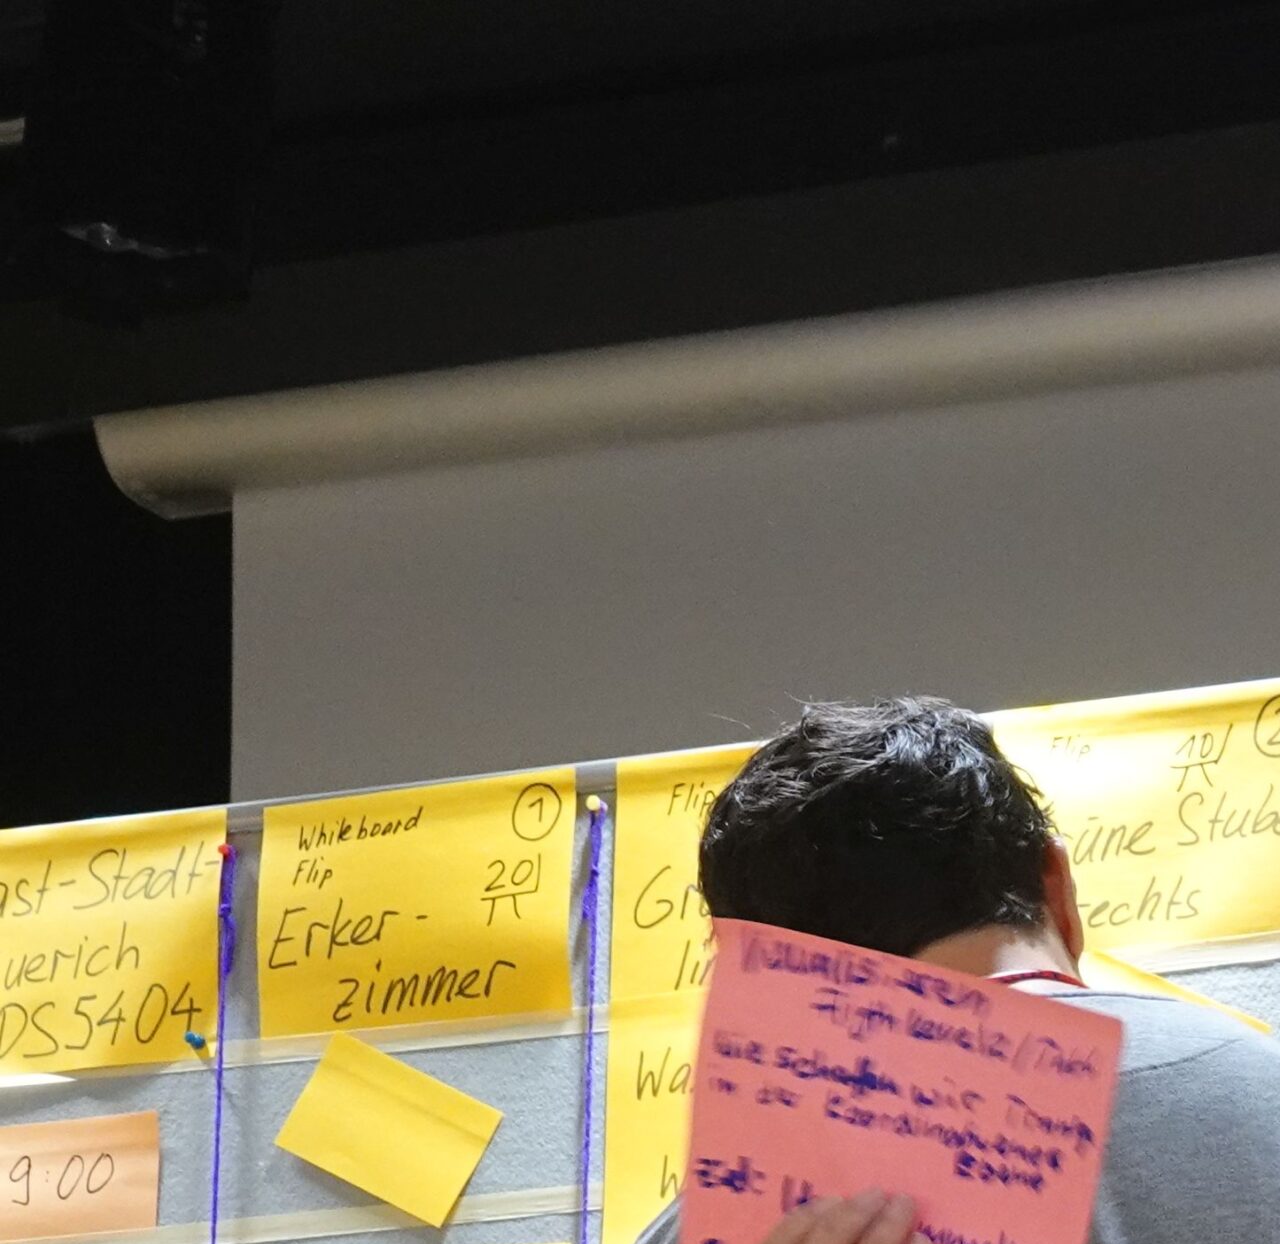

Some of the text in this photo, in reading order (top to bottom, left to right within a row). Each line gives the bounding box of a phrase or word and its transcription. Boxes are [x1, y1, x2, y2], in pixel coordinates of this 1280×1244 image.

[1061, 816, 1156, 866] üne
[293, 856, 333, 889] Flip
[331, 958, 517, 1023] zimmer
[636, 1045, 695, 1102] Wa
